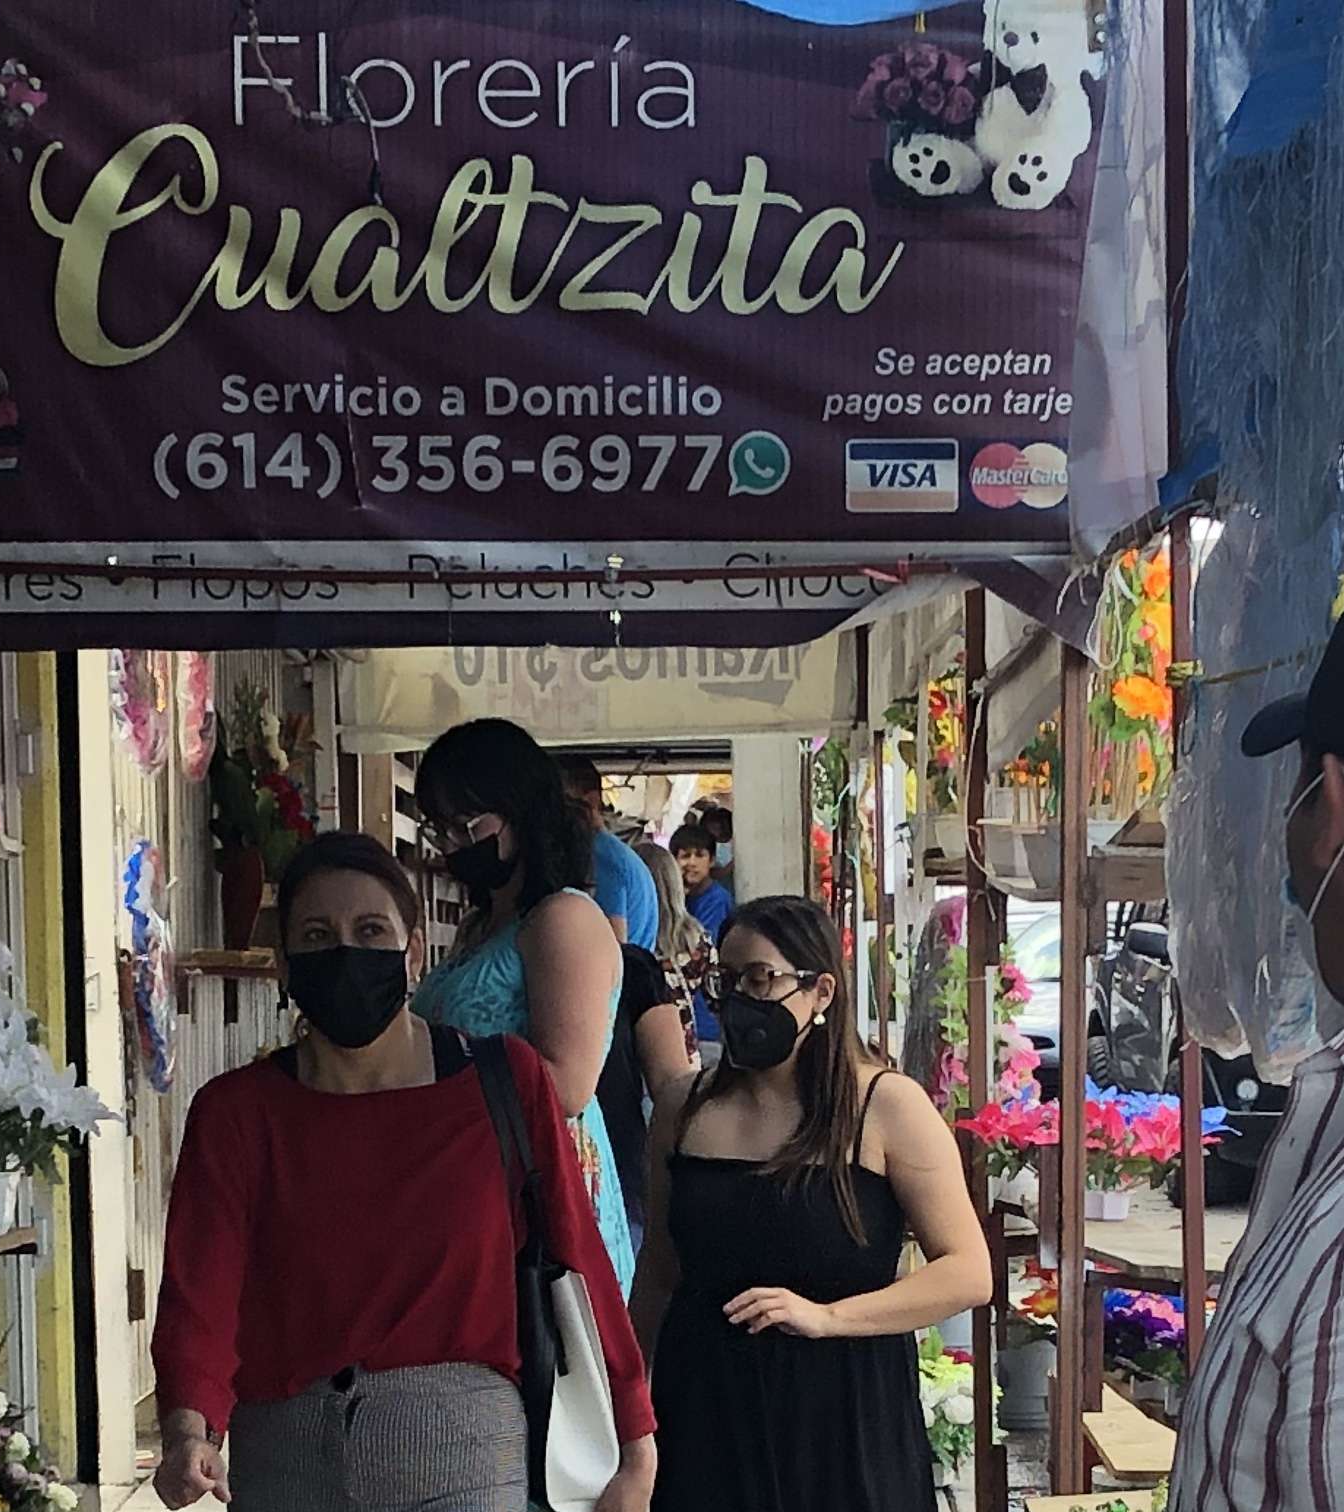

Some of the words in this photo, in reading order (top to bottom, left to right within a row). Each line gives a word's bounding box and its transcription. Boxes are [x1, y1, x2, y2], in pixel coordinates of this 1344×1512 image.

[233, 35, 697, 130] Florería
[29, 122, 904, 368] Cualtzita
[874, 348, 916, 376] Se
[925, 350, 1052, 381] aceptan
[221, 375, 424, 418] Servicio
[440, 387, 465, 418] a
[485, 375, 723, 418] Domicilio
[822, 393, 922, 422] pagos
[933, 393, 991, 417] con
[154, 432, 342, 501] (614)
[371, 433, 723, 494] 356-6977
[867, 462, 938, 488] VISA
[408, 552, 656, 600] Peluches
